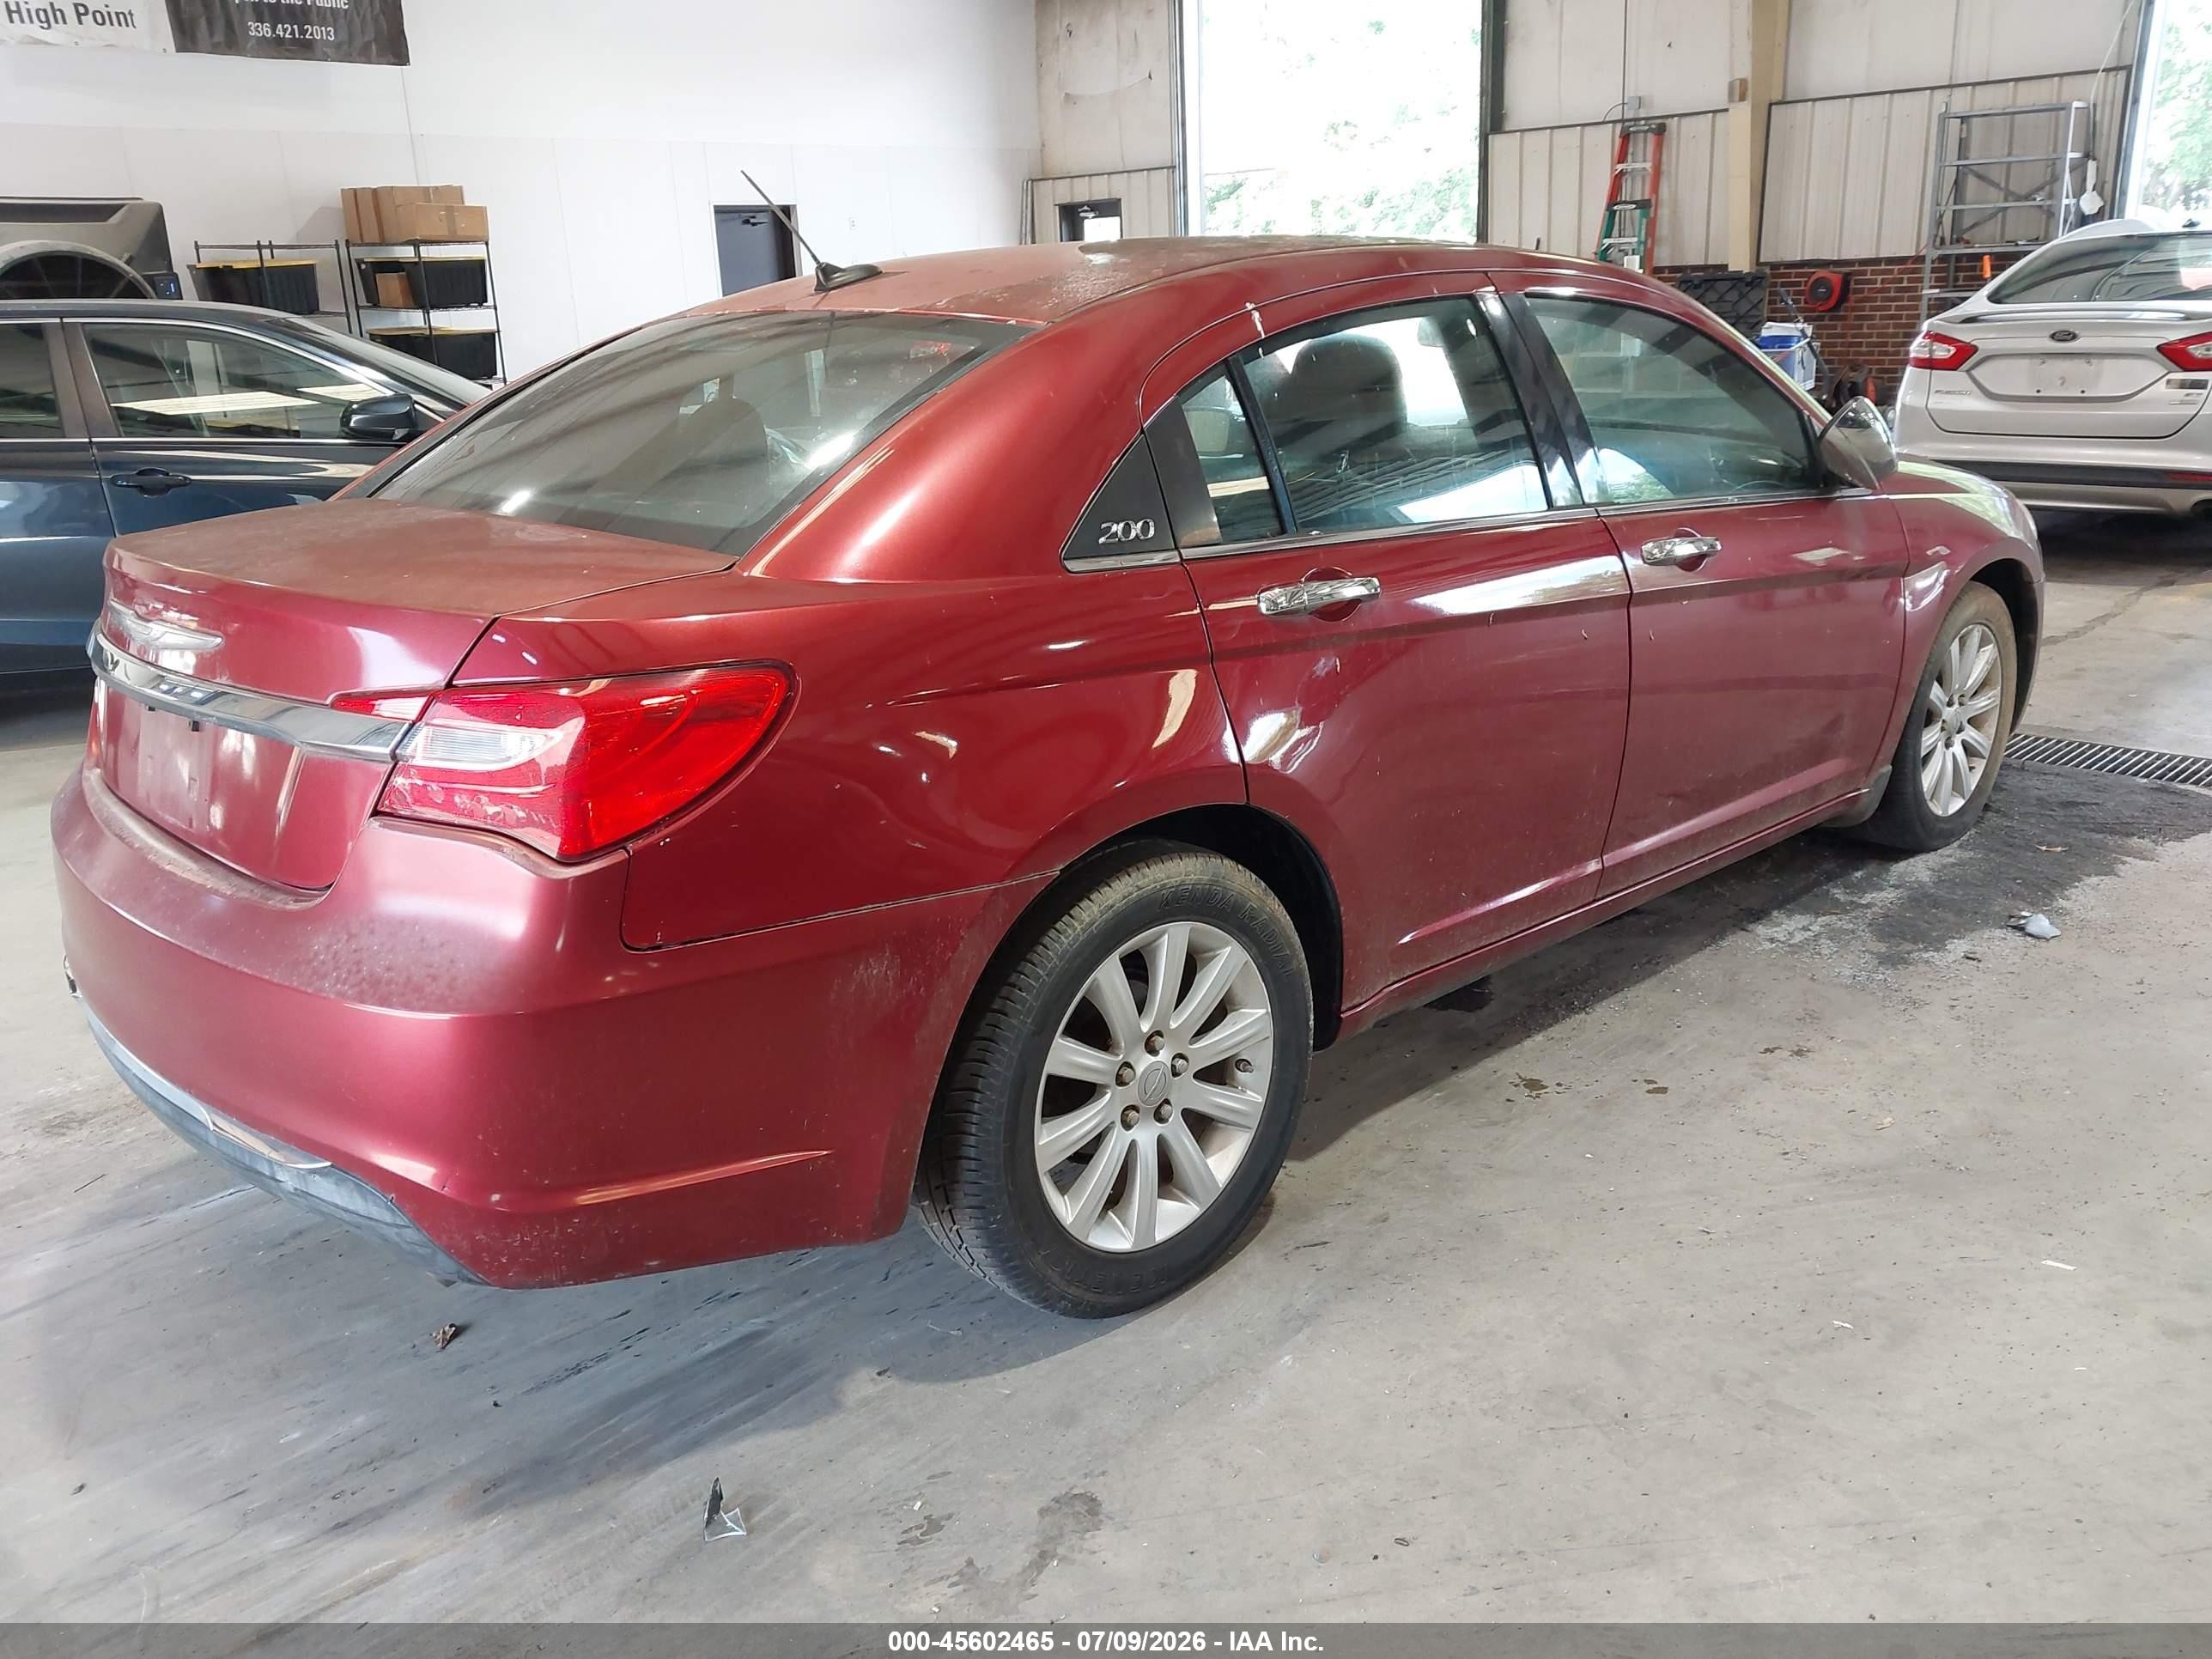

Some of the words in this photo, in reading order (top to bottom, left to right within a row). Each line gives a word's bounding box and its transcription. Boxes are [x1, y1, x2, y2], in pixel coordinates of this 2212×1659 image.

[4, 1, 67, 30] High
[72, 3, 137, 29] Point
[247, 21, 335, 40] 336.421.2013
[1099, 519, 1154, 544] 200
[1158, 884, 1237, 913] KENDA
